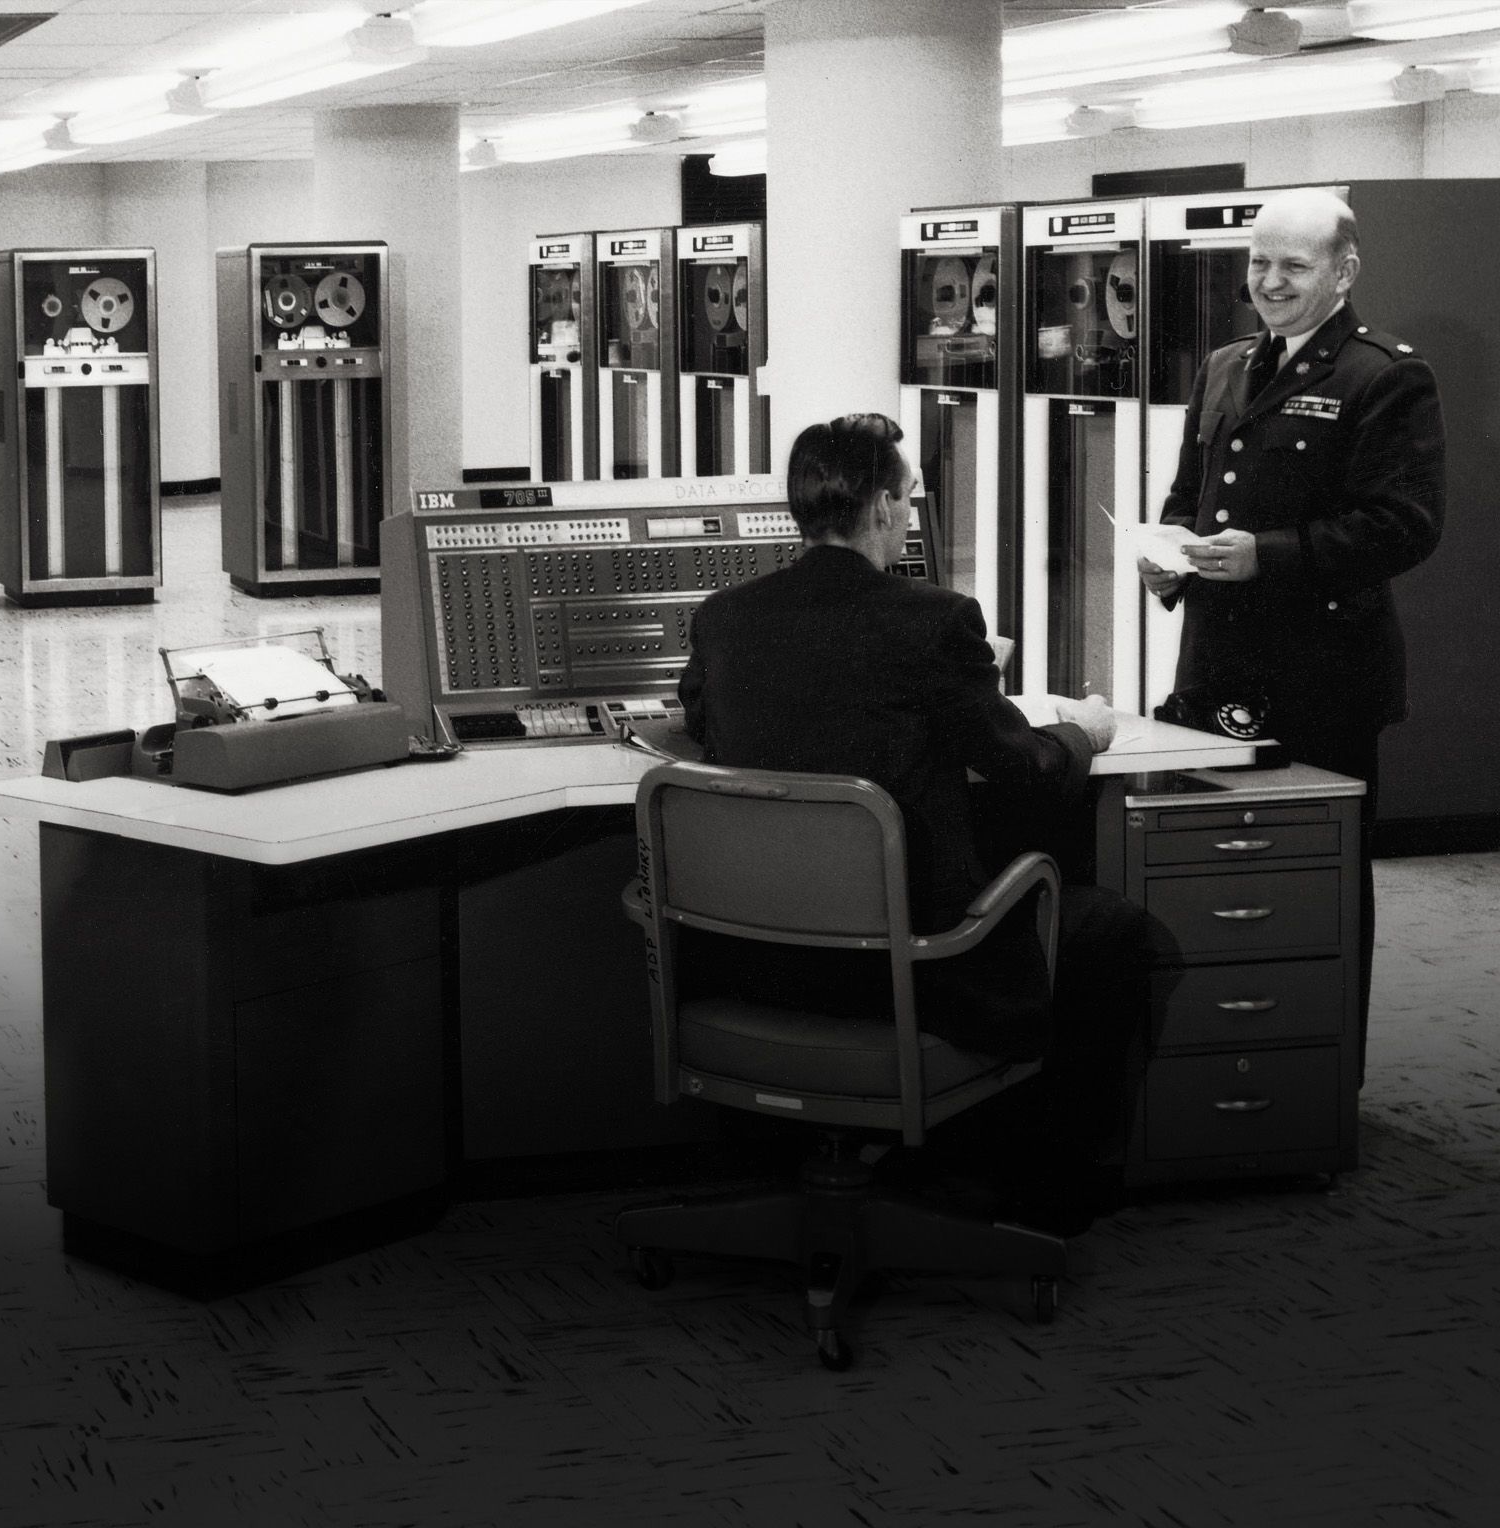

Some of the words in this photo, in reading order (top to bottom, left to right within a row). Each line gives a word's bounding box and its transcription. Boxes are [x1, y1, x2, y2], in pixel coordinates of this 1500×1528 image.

[419, 493, 455, 509] IBM
[504, 490, 536, 506] 705
[675, 484, 717, 499] DATA
[728, 481, 787, 497] PROCE
[639, 838, 652, 919] LIBRARY
[646, 938, 660, 984] ADP
